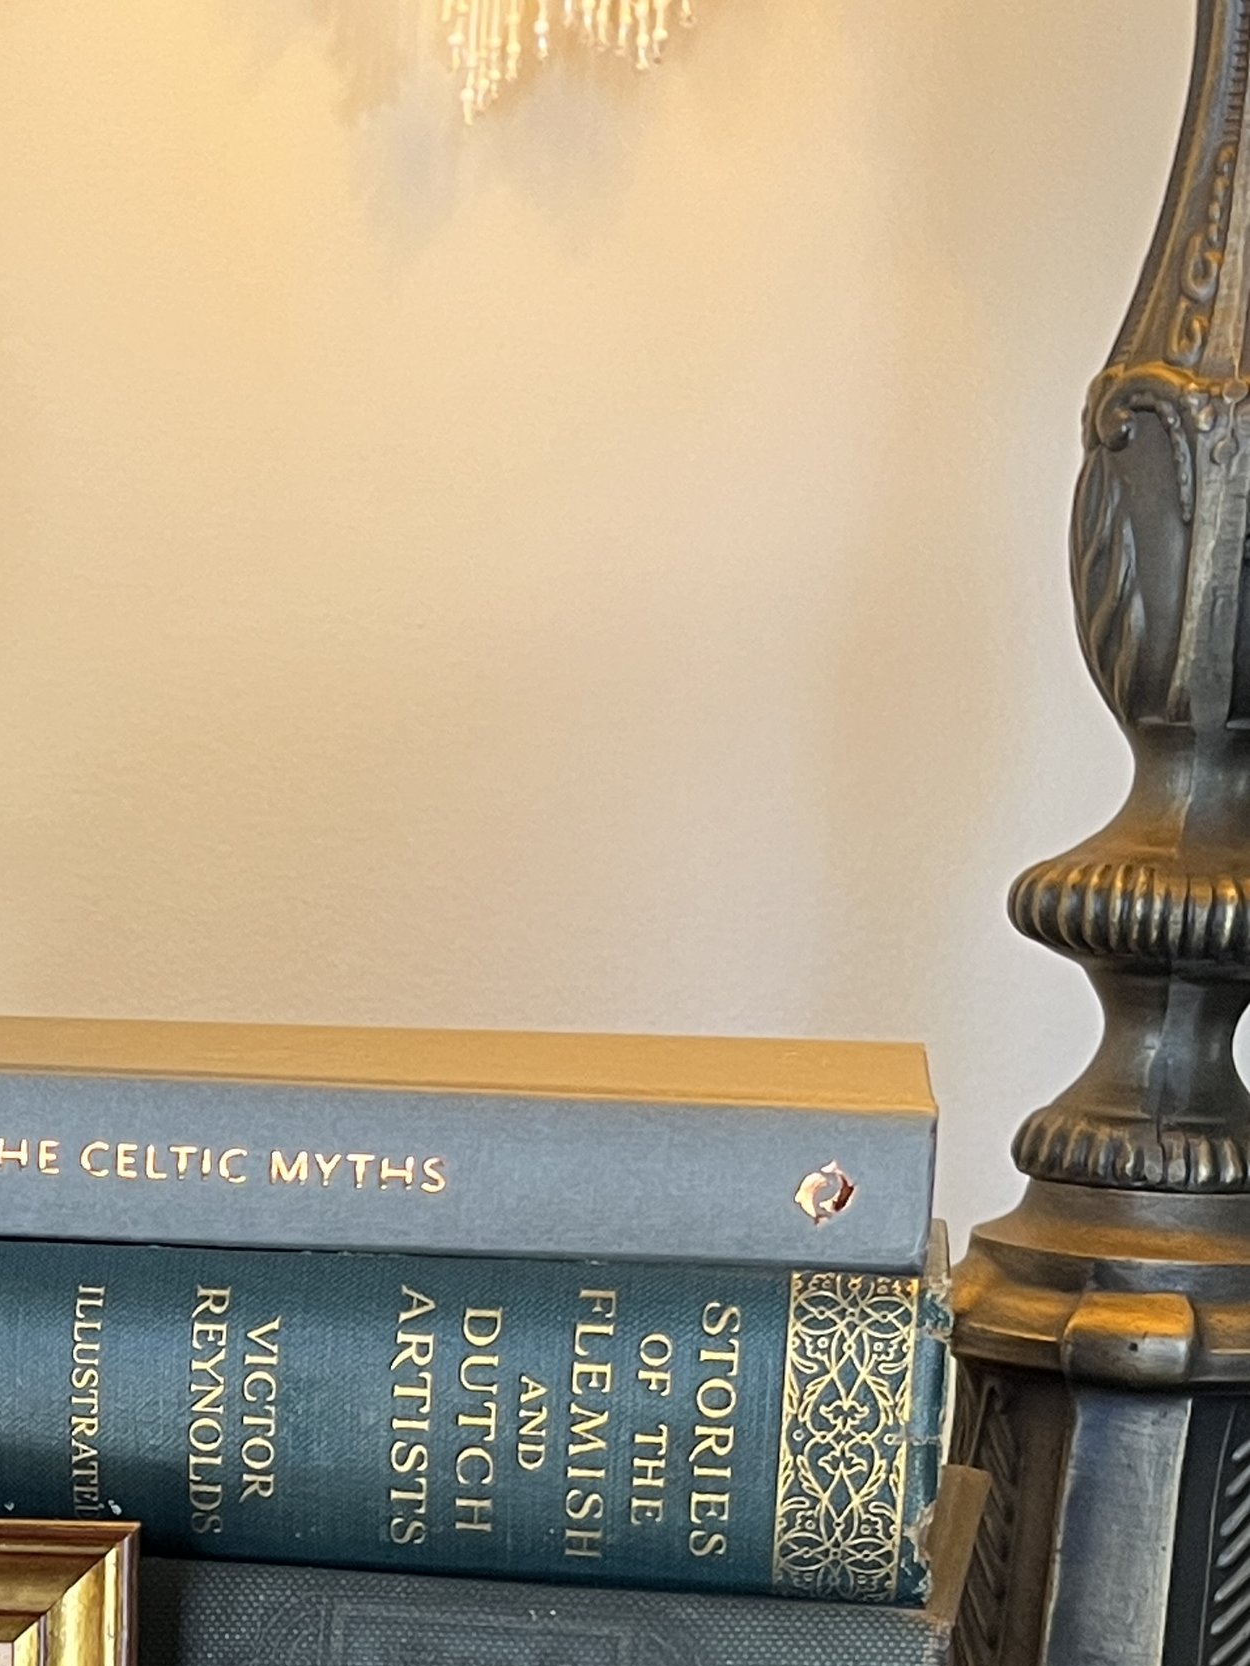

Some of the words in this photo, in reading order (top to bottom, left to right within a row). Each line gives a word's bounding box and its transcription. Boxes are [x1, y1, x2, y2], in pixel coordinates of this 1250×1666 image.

[79, 1140, 249, 1184] CELTIC
[269, 1149, 448, 1194] MYTHS
[187, 1285, 232, 1536] REYNOLDS
[240, 1316, 283, 1503] VICTOR
[388, 1284, 437, 1547] ARTISTS
[454, 1306, 504, 1535] DUTCH
[516, 1374, 548, 1472] AND
[563, 1288, 618, 1561] FLEMISH
[636, 1332, 674, 1397] OF
[687, 1300, 743, 1560] STORIES
[630, 1424, 669, 1525] THE
